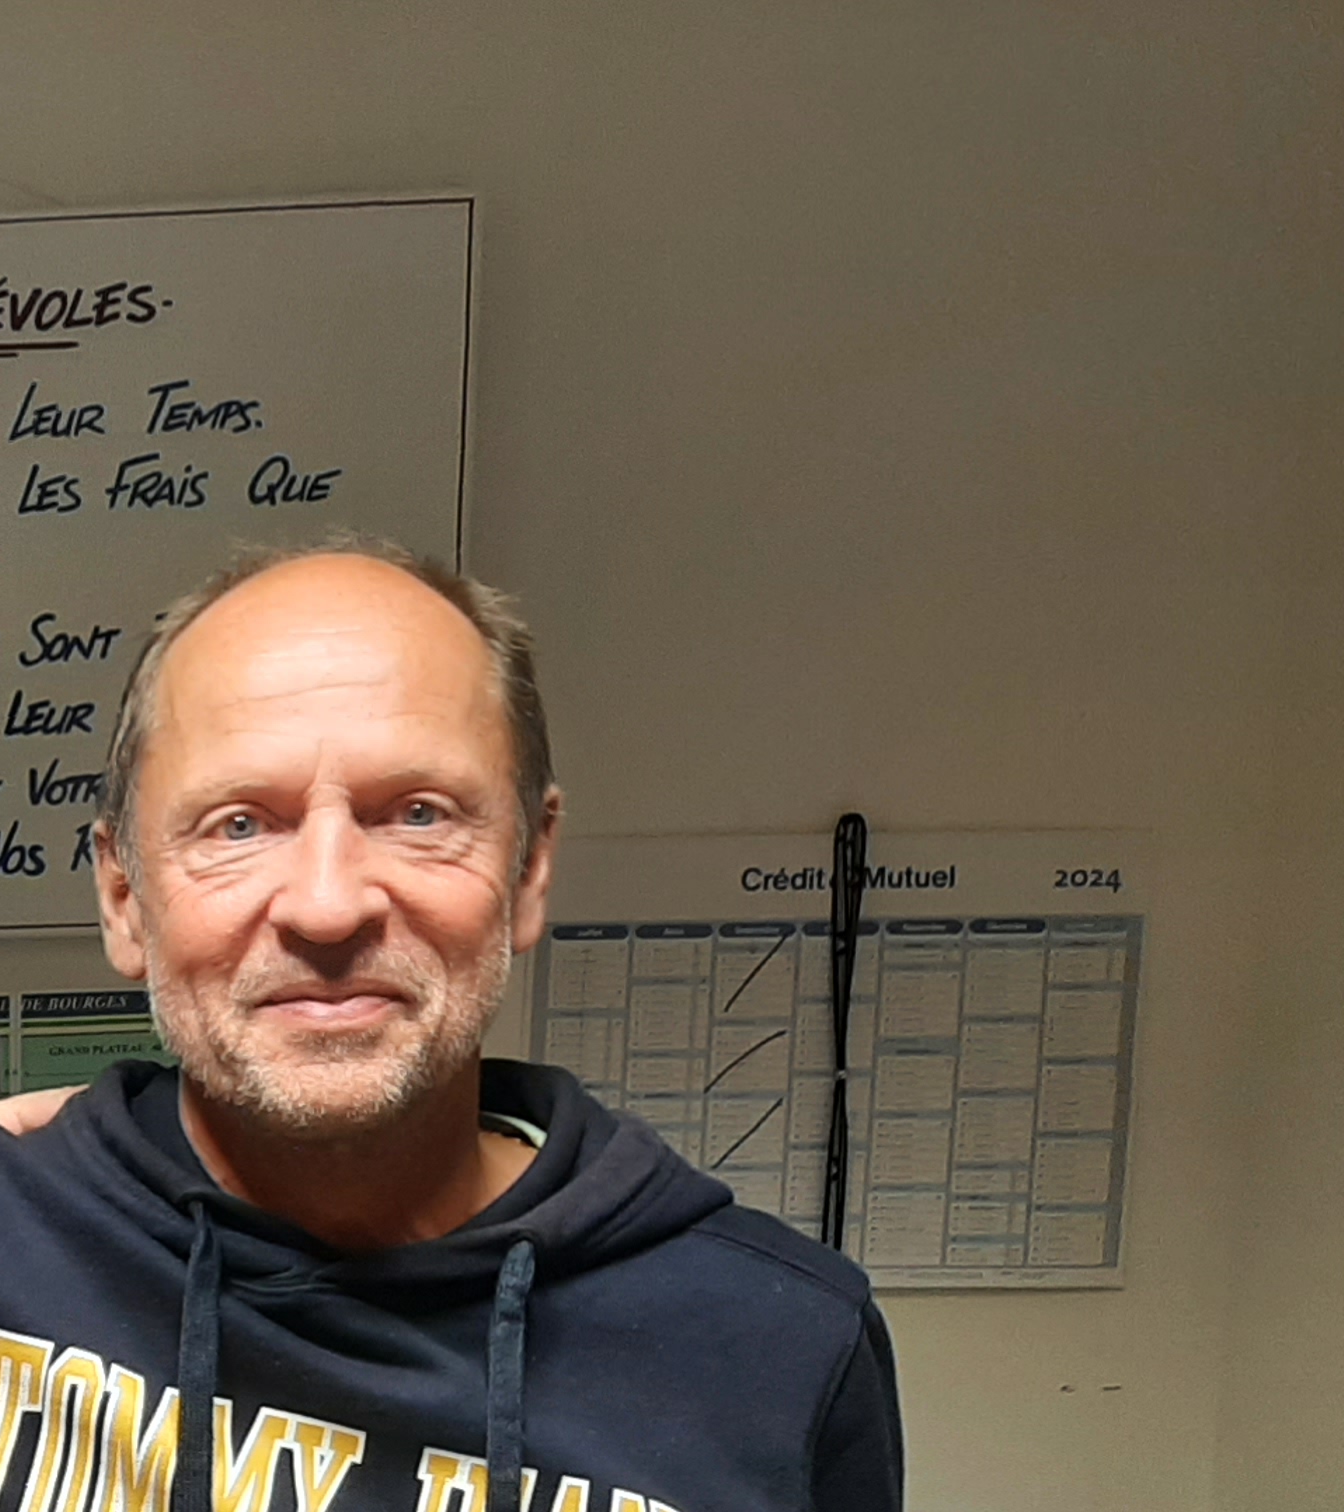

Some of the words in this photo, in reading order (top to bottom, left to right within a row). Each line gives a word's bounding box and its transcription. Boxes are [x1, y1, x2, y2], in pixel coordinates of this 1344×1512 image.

[26, 756, 106, 808] VOTR
[740, 865, 826, 893] Crédit
[863, 864, 955, 890] Mutuel
[1053, 866, 1123, 893] 2024
